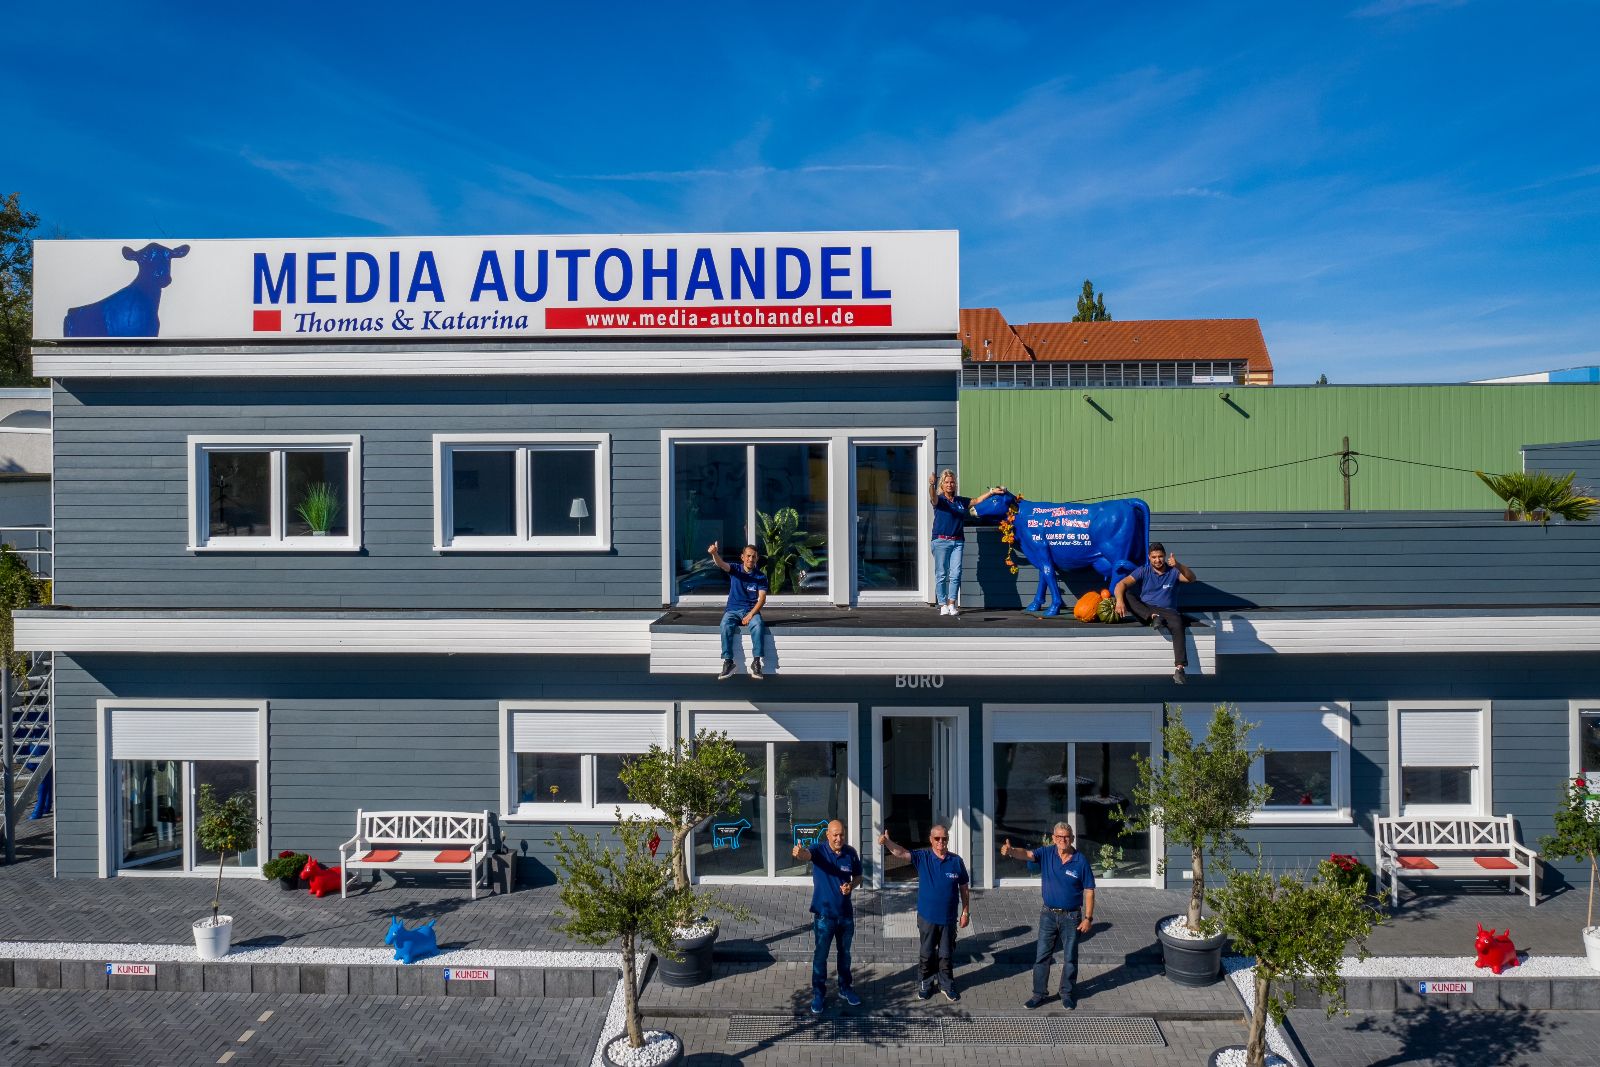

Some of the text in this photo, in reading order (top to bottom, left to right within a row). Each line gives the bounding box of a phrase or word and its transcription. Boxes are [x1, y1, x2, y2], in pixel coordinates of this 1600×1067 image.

[253, 246, 892, 304] MEDIA AUTOHANDEL
[293, 309, 529, 333] Thomas & Katarina
[585, 307, 855, 327] www.media-autohandel.de
[1077, 533, 1090, 541] 100
[117, 965, 150, 974] KUNDEN
[455, 970, 489, 979] KUNDEN
[1431, 983, 1467, 992] KUNDEN
